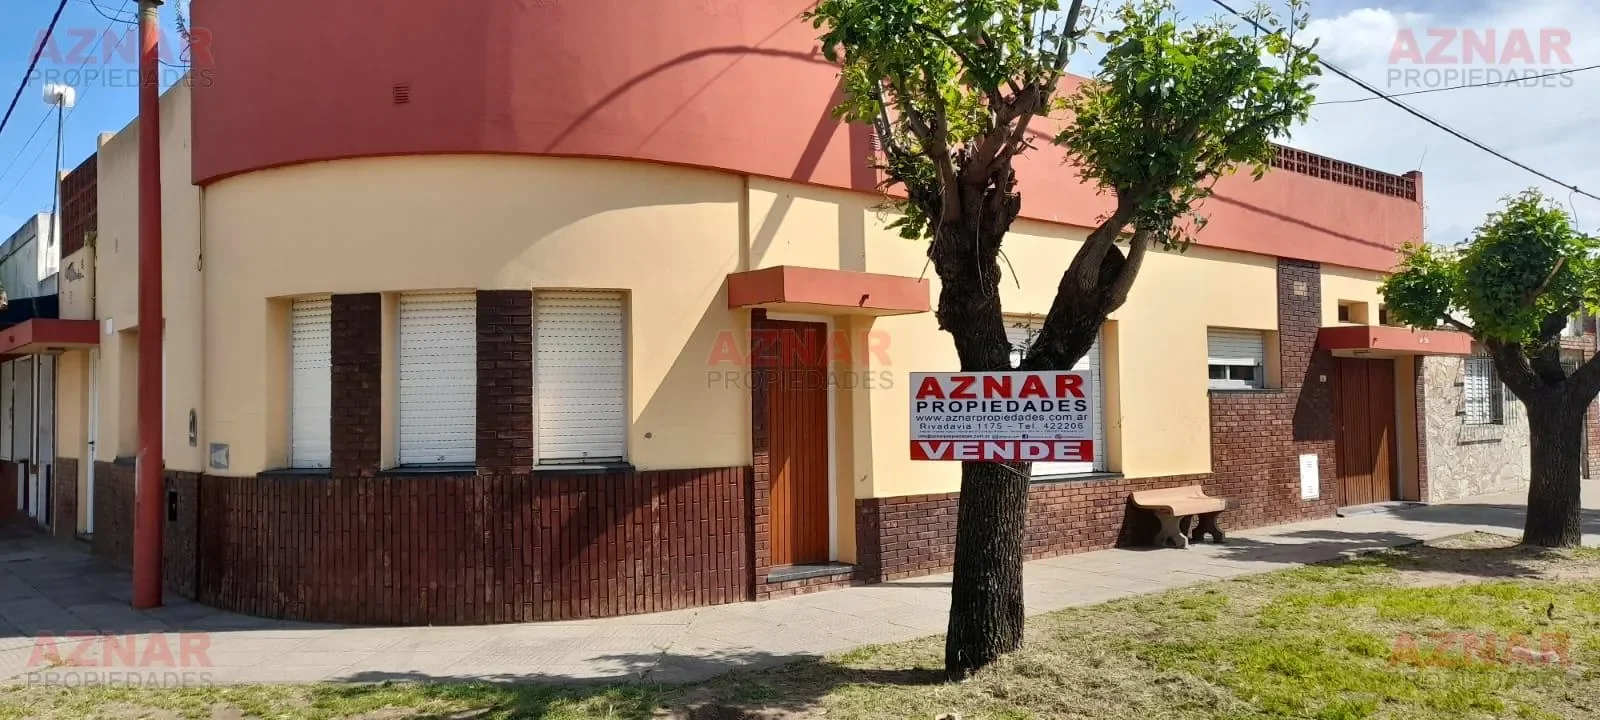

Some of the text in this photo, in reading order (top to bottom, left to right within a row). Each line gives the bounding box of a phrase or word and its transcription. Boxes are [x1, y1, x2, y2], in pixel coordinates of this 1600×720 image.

[916, 375, 1085, 399] AZNAR
[917, 400, 1087, 412] PROPIEDADES
[920, 422, 972, 430] Rivadavia
[978, 422, 1002, 430] 1175
[1043, 422, 1084, 430] 422206
[918, 441, 1082, 460] VENDE
